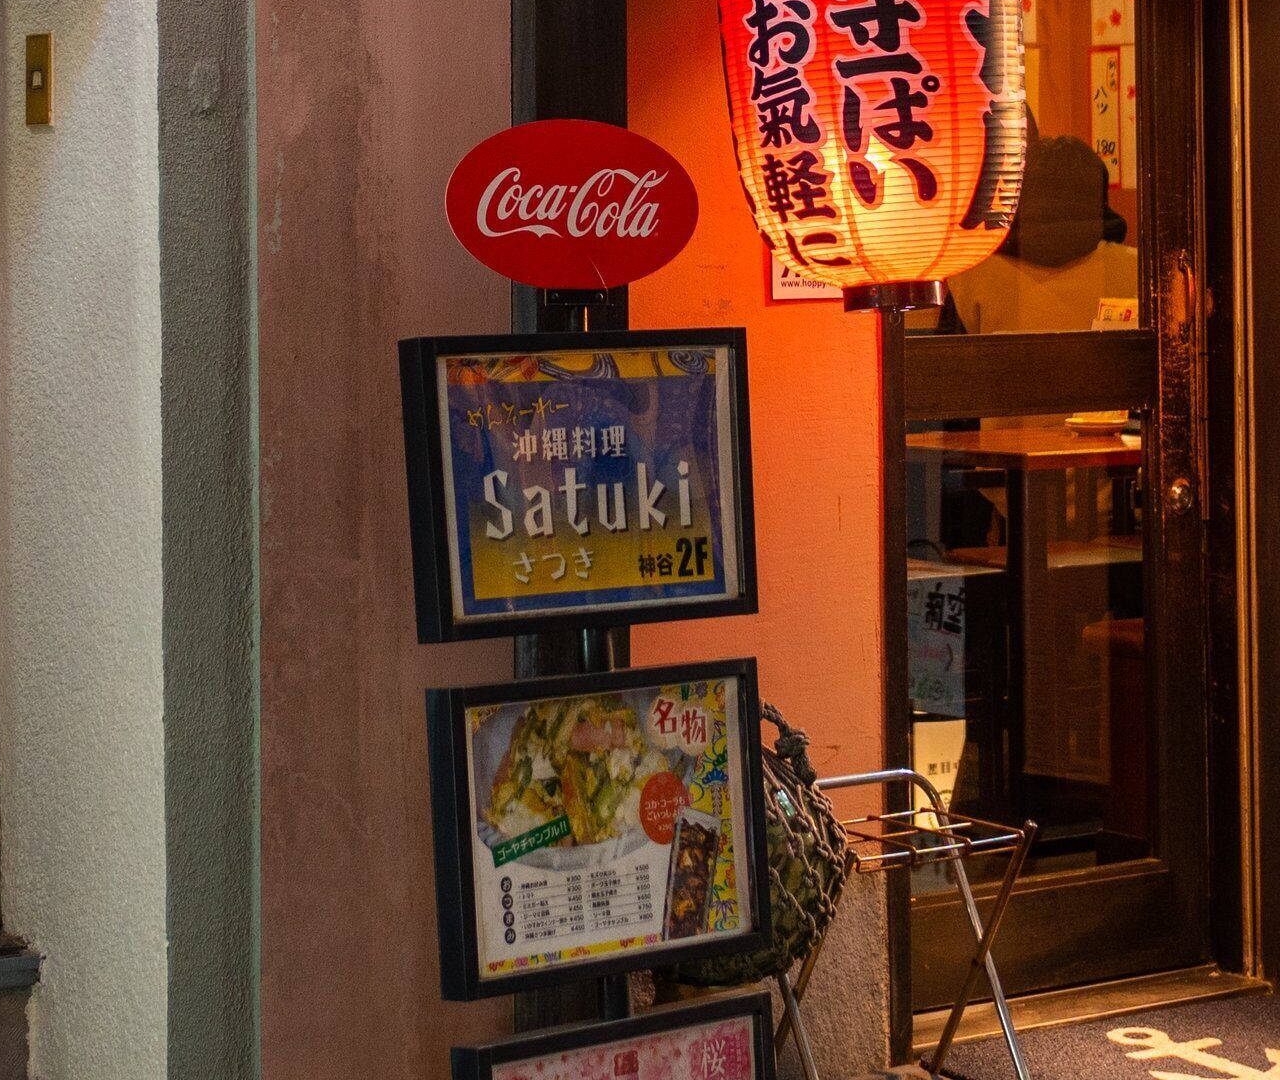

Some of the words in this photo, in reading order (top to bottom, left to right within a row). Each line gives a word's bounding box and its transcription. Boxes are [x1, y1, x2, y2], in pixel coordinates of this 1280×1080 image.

[476, 167, 670, 238] Coca-Cola
[511, 425, 627, 463] 沖縄料理
[482, 459, 693, 541] Satuki
[512, 546, 595, 585] さつき
[653, 698, 708, 744] 名物
